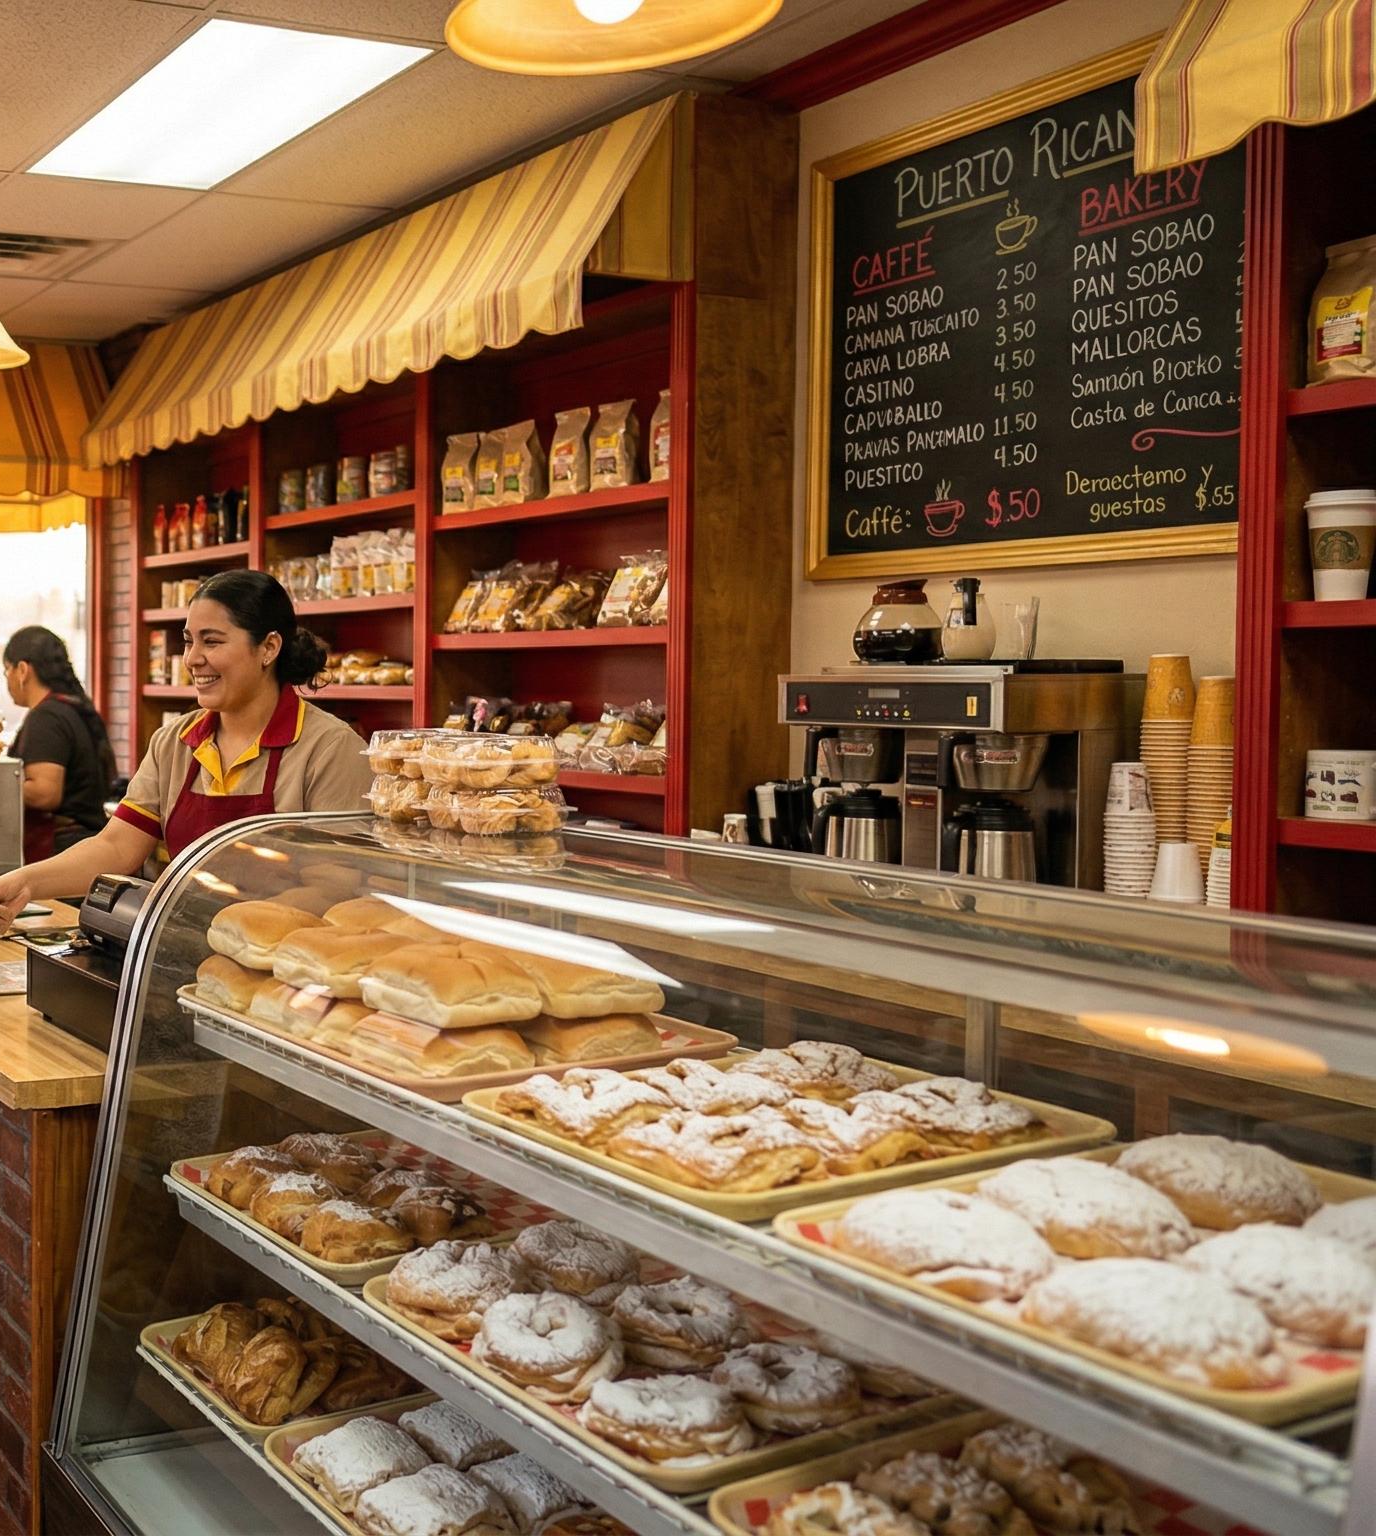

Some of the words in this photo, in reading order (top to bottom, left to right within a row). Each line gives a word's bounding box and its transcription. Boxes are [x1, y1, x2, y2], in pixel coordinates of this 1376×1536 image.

[894, 146, 1014, 218] PUERTO
[1080, 157, 1210, 229] BAKERY
[852, 225, 936, 289] CAFFÉ
[1073, 237, 1117, 271] PAN
[1131, 213, 1215, 257] SOBAO
[1073, 273, 1115, 303] PAN
[1126, 252, 1204, 291] SOBAO
[846, 305, 879, 330] PAN
[996, 292, 1036, 320] 3.50
[1071, 291, 1179, 334] QUESITOS
[844, 354, 891, 381] CARVA
[896, 341, 951, 370] LOBRA
[995, 319, 1036, 348] 3.50
[1070, 317, 1203, 366] MALLORCAS
[844, 376, 915, 408] CASITNO
[993, 348, 1036, 373] 4.50
[993, 379, 1035, 404] 4.50
[992, 411, 1037, 438] 11.50
[1070, 400, 1127, 430] Casta
[1133, 398, 1156, 419] de
[844, 462, 924, 491] PUESTTCO
[993, 443, 1037, 468] 4.50
